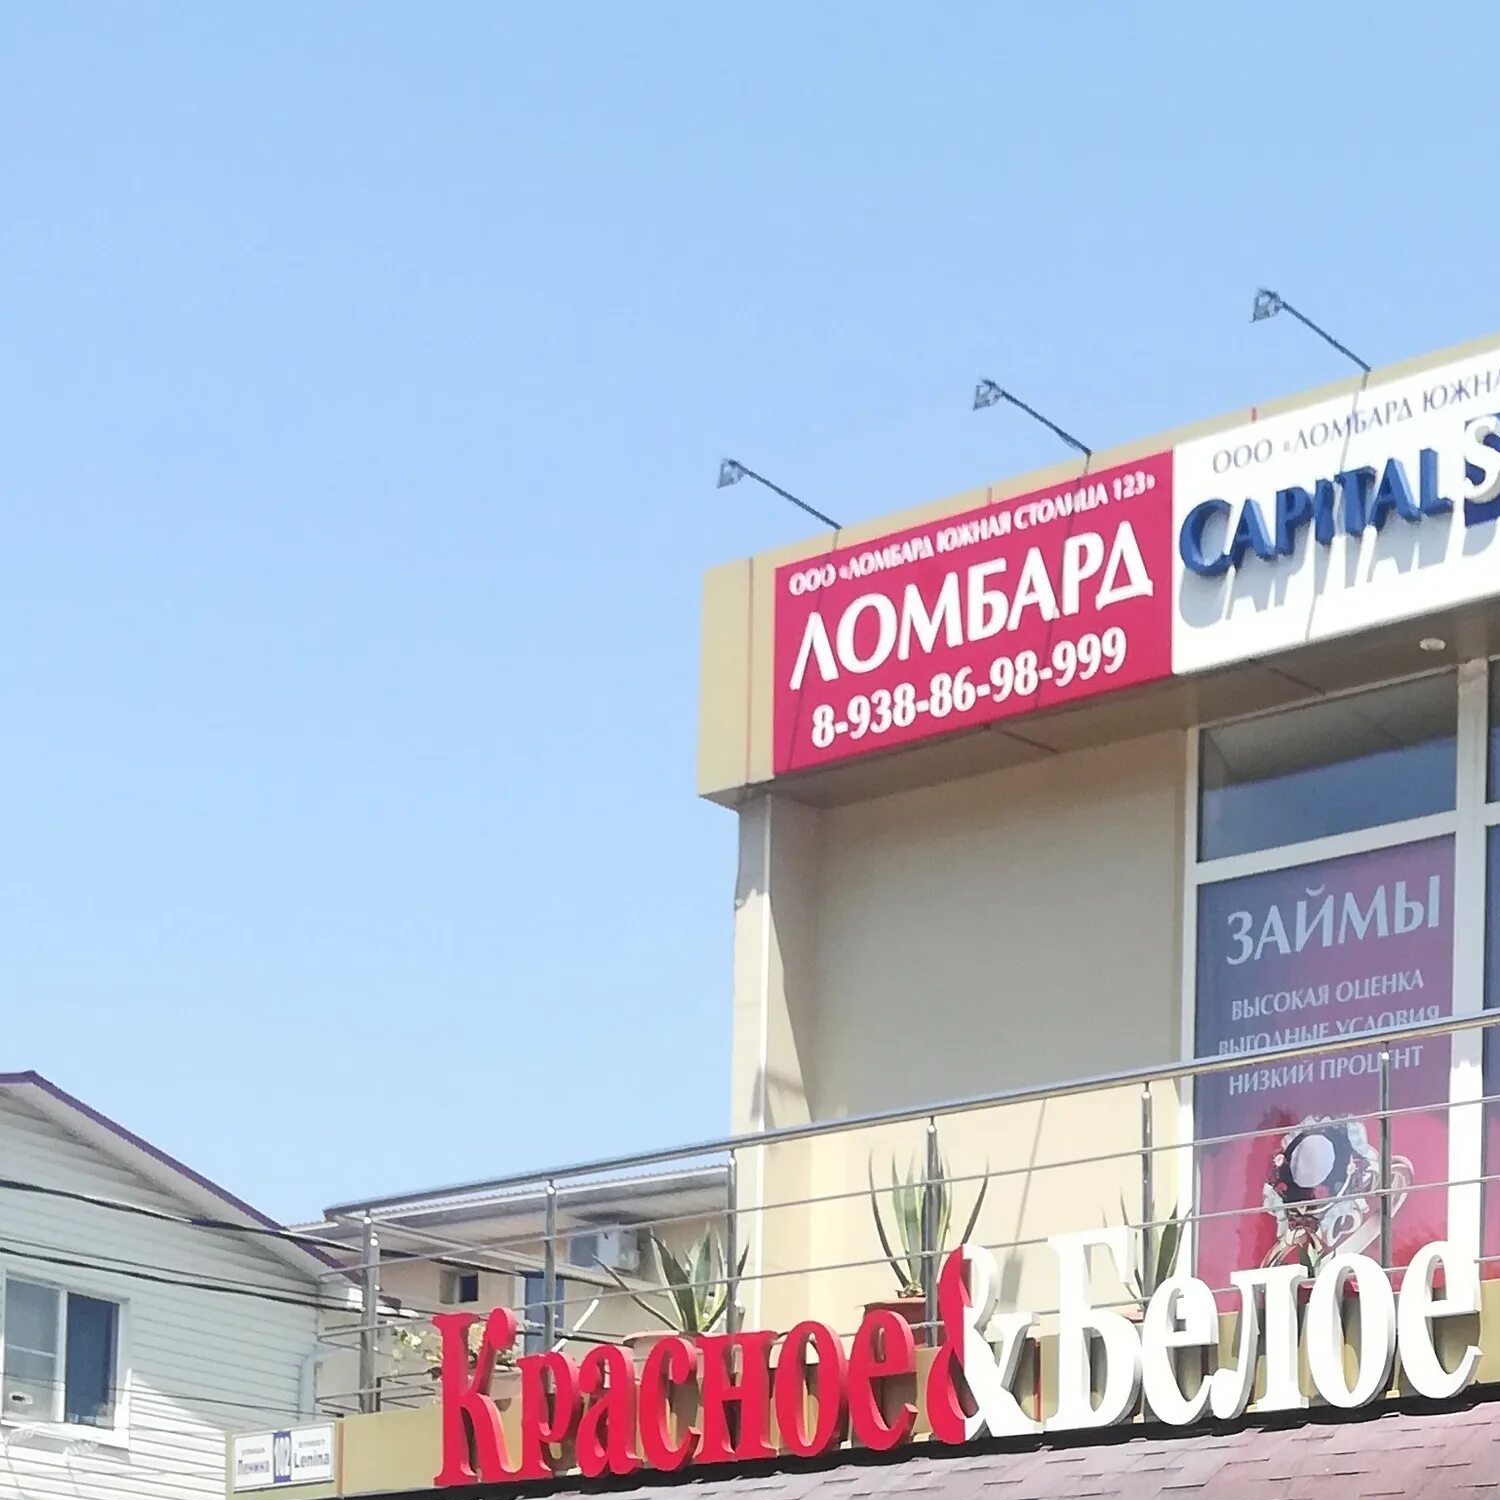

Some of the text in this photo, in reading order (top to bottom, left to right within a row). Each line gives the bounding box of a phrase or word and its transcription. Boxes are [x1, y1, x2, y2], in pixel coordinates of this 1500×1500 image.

[1211, 437, 1274, 475] ООО
[788, 561, 836, 597] ООО
[936, 509, 1012, 556] ЮЖНАЯ
[1013, 481, 1110, 531] СТОЛИЦА
[788, 520, 1155, 691] ЛОМБАРД
[811, 626, 1128, 749] 8-938-86-98-999
[1225, 874, 1441, 966] ЗАЙМЫ
[1231, 968, 1425, 1022] ВЫСОКАЯ ОЦЕНКА
[1229, 1045, 1425, 1097] НИЗКИЙ ПРОЦНТ
